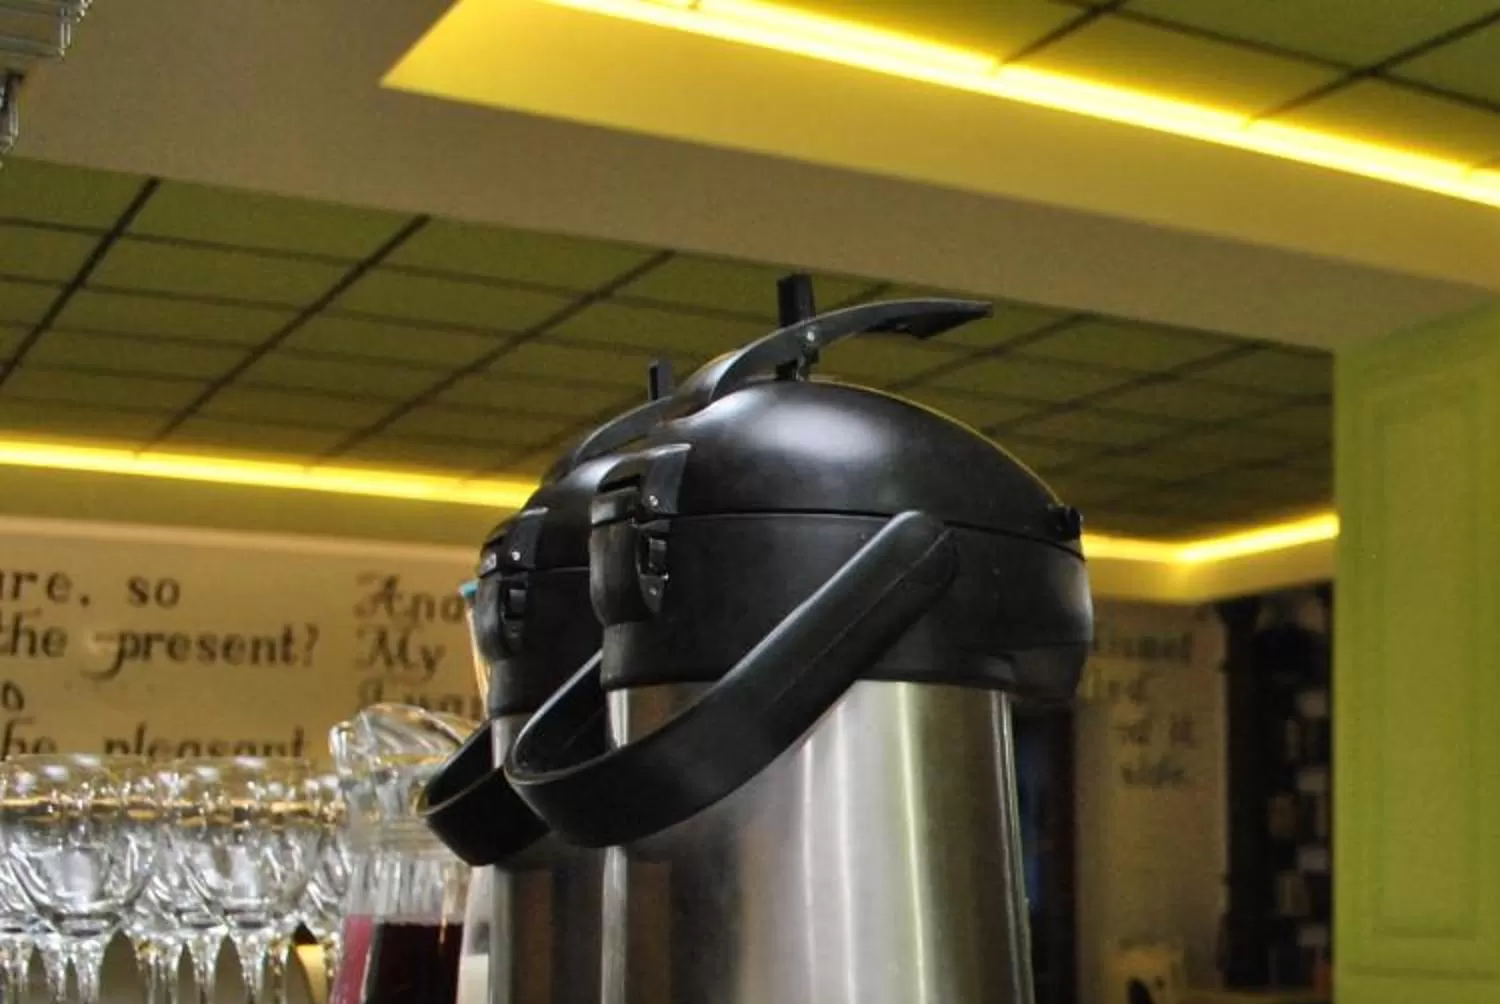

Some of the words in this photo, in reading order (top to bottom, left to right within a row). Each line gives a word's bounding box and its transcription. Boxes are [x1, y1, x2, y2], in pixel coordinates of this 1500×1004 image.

[124, 573, 183, 610] so
[80, 622, 320, 682] present?
[353, 622, 447, 684] My
[104, 722, 304, 757] leasant
